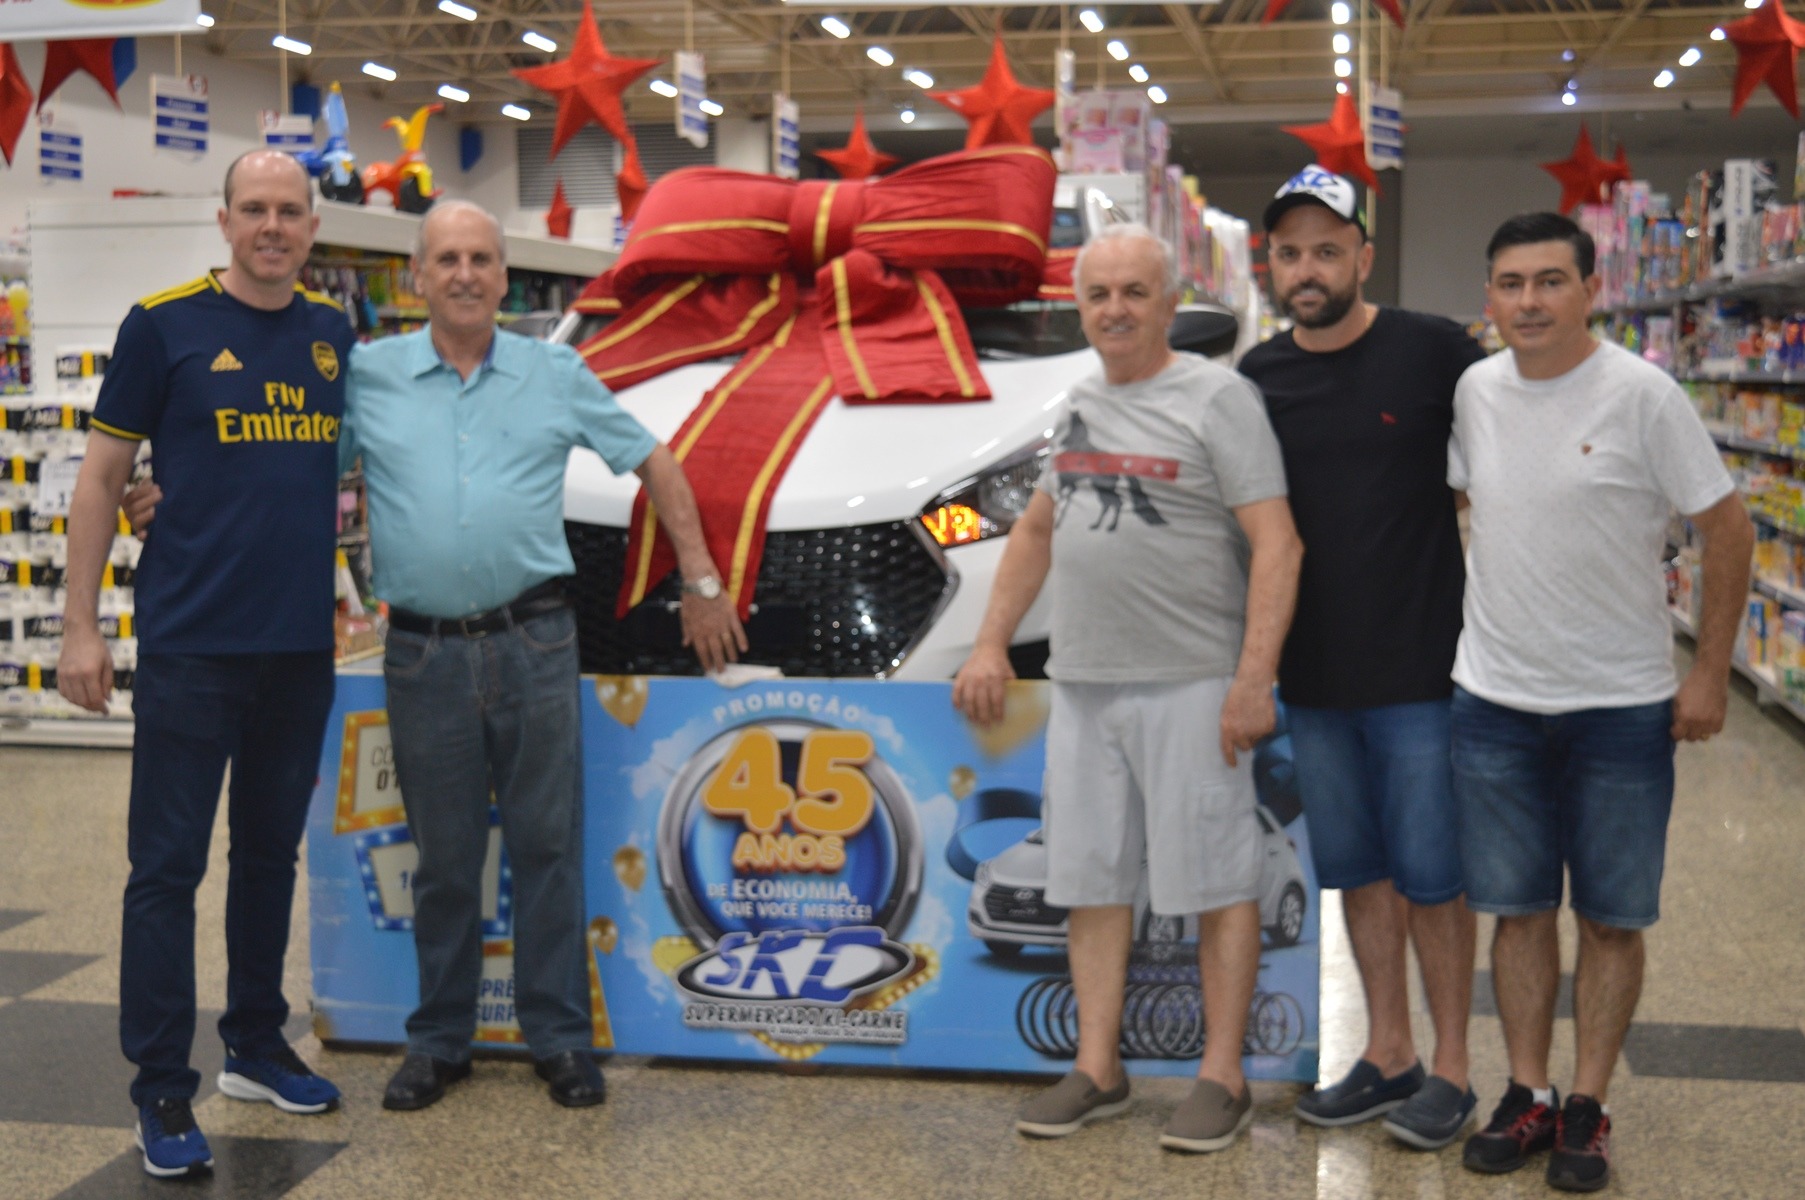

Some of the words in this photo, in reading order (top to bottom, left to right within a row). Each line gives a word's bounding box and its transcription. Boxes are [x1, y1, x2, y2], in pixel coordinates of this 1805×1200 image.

[264, 382, 305, 411] Fly
[712, 691, 862, 725] PROMOÇÃO
[704, 727, 875, 836] 45
[733, 833, 846, 871] ANOS
[706, 882, 729, 898] DE
[732, 877, 859, 905] ECONOMIA,
[720, 900, 754, 918] QUE
[684, 1003, 820, 1026] SUPERMERCADO
[822, 1008, 907, 1030] KI-CARNE
